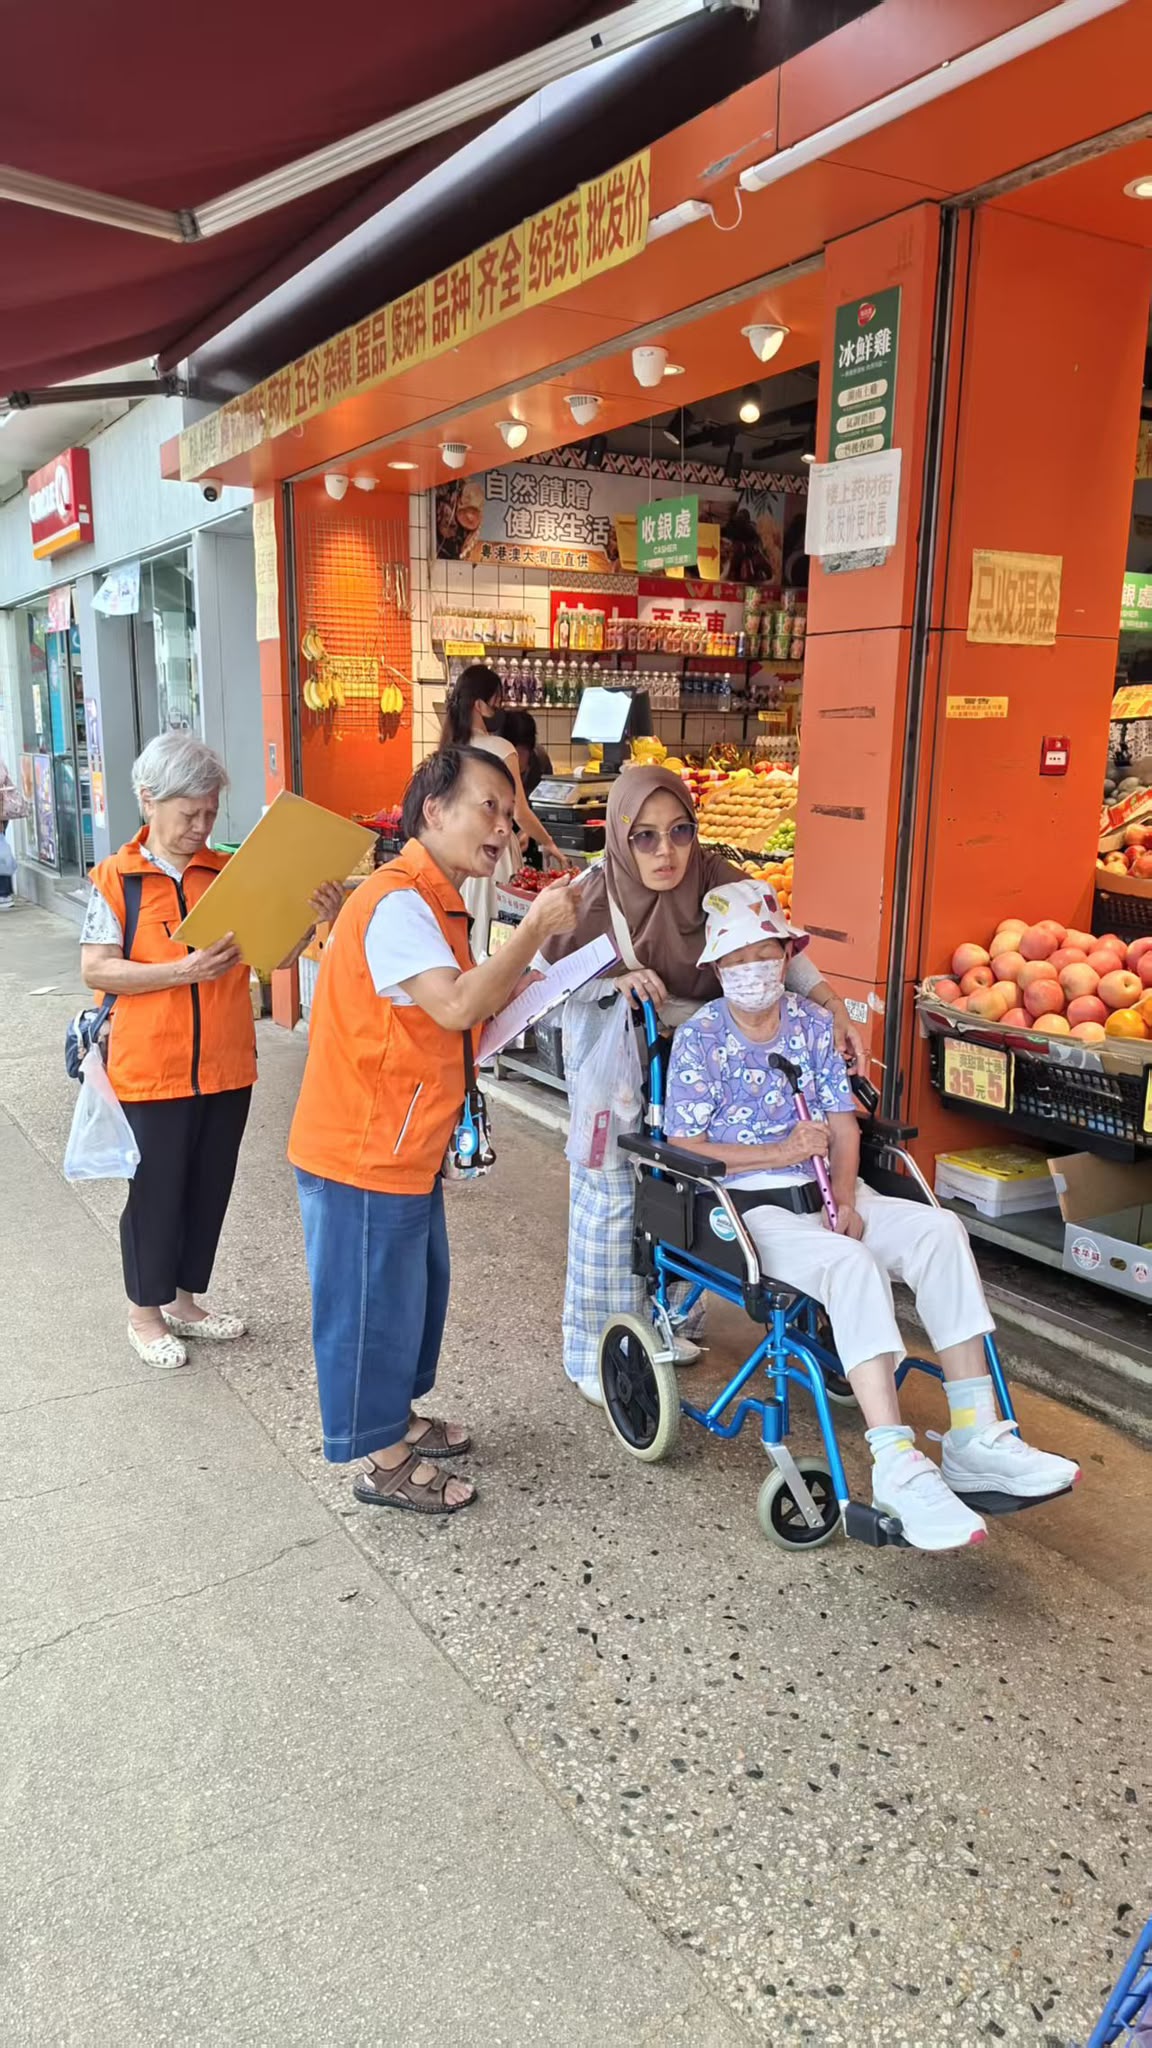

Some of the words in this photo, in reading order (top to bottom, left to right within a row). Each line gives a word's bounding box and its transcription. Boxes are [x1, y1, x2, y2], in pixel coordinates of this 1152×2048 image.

[838, 327, 892, 369] 冰鮮雞
[484, 469, 592, 511] 自然饋贈
[504, 506, 611, 547] 健康生活
[641, 508, 691, 544] 收銀處
